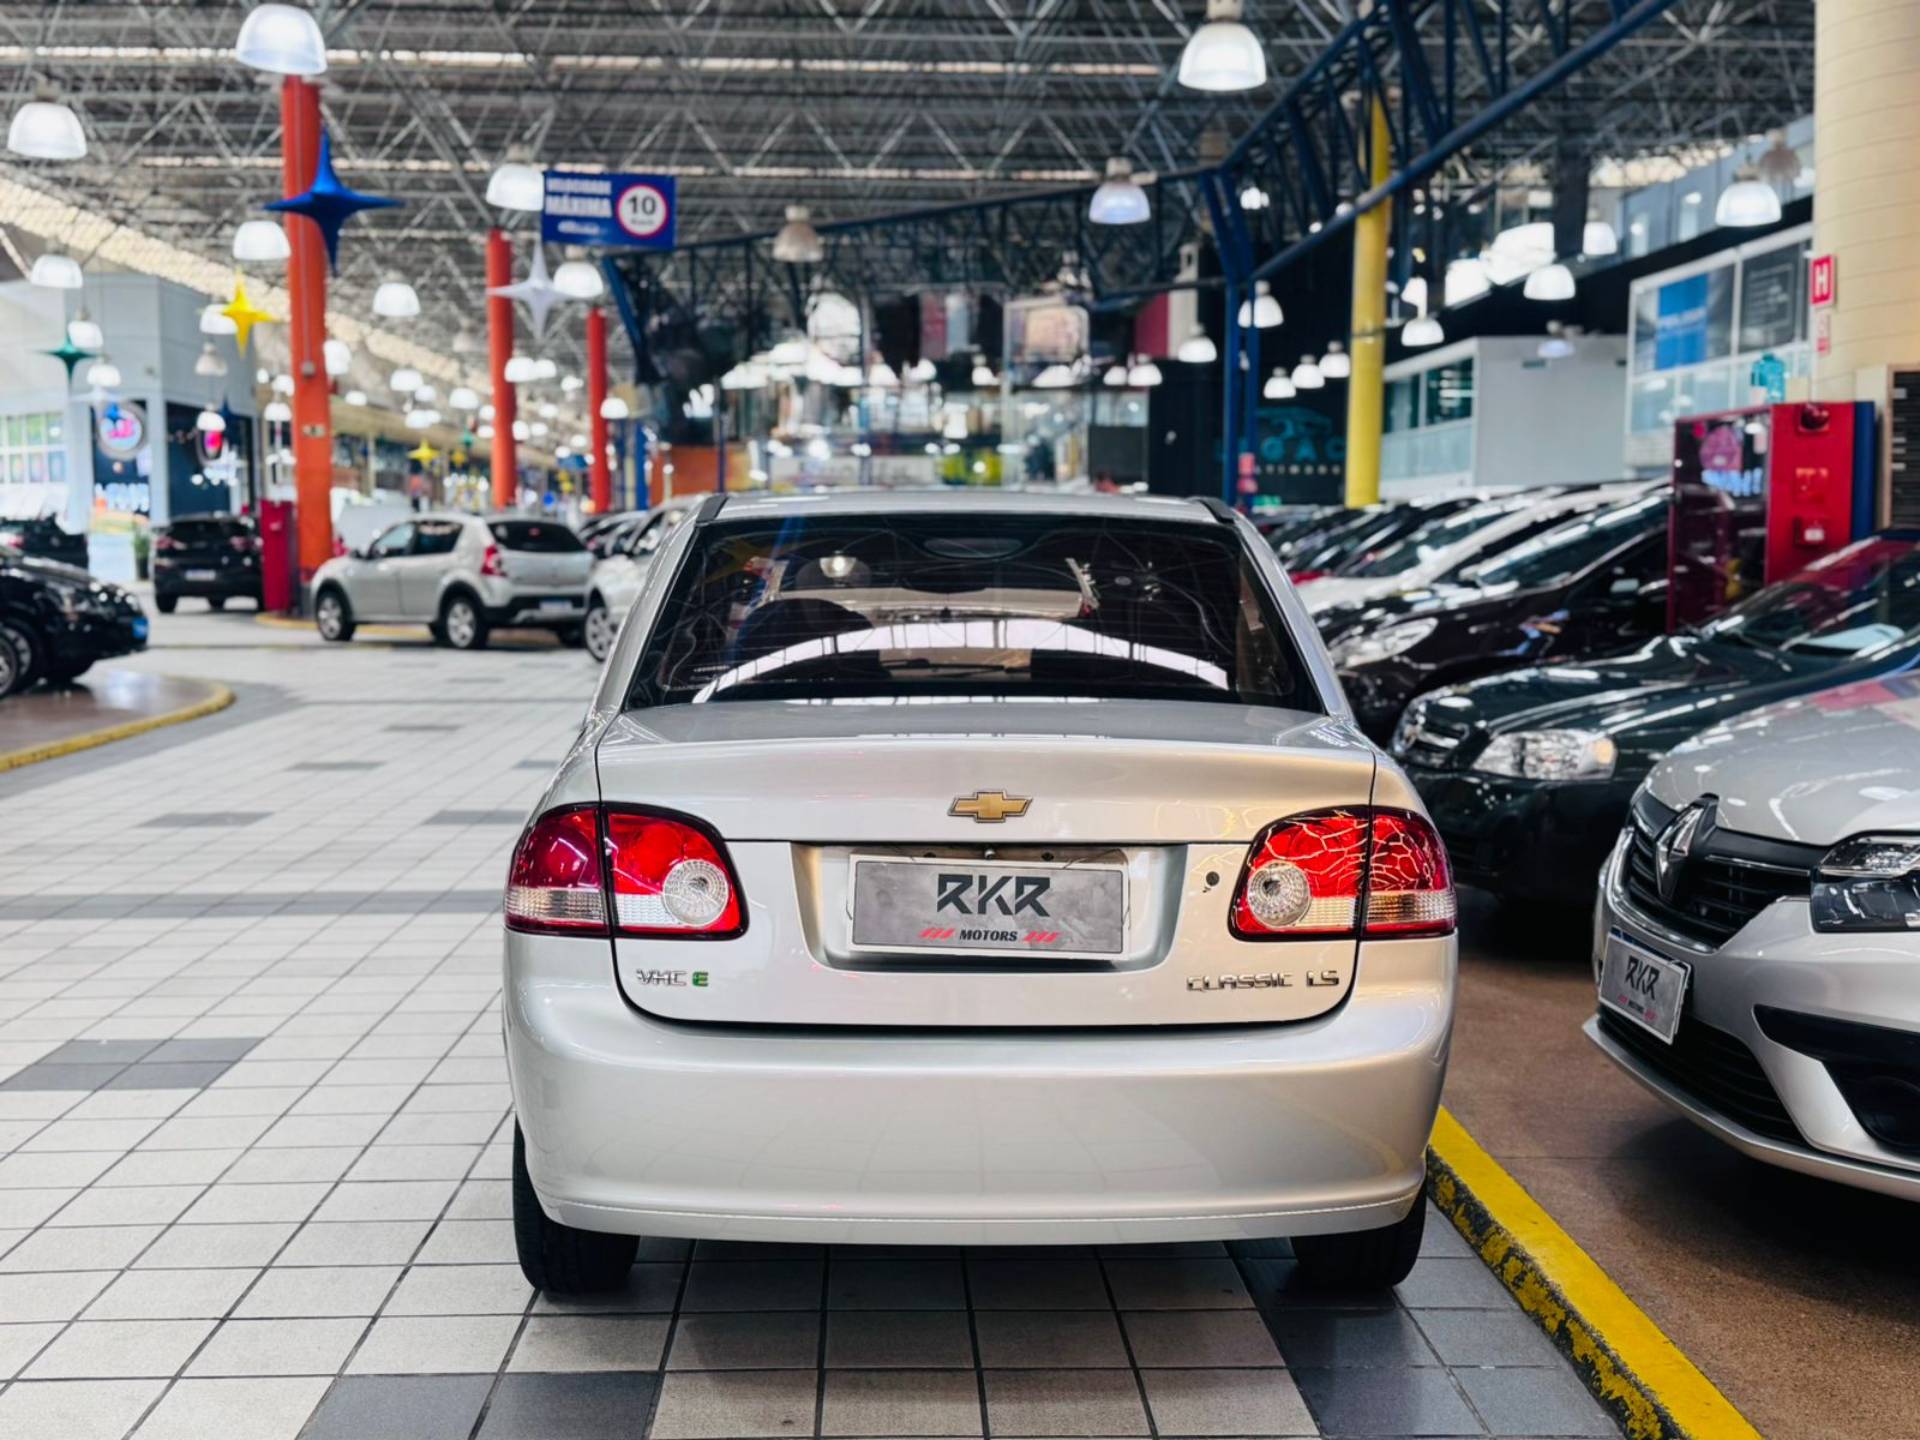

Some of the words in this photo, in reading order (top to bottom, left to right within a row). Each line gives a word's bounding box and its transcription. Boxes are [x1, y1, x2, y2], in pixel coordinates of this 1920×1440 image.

[628, 194, 657, 215] 10
[1814, 262, 1829, 298] H
[937, 873, 1050, 917] RKR
[959, 929, 1018, 942] MOTORS
[636, 968, 688, 987] VHC
[692, 971, 709, 987] E
[1186, 972, 1294, 992] CLASSIC
[1306, 970, 1340, 987] LS
[1625, 955, 1660, 1000] RKR
